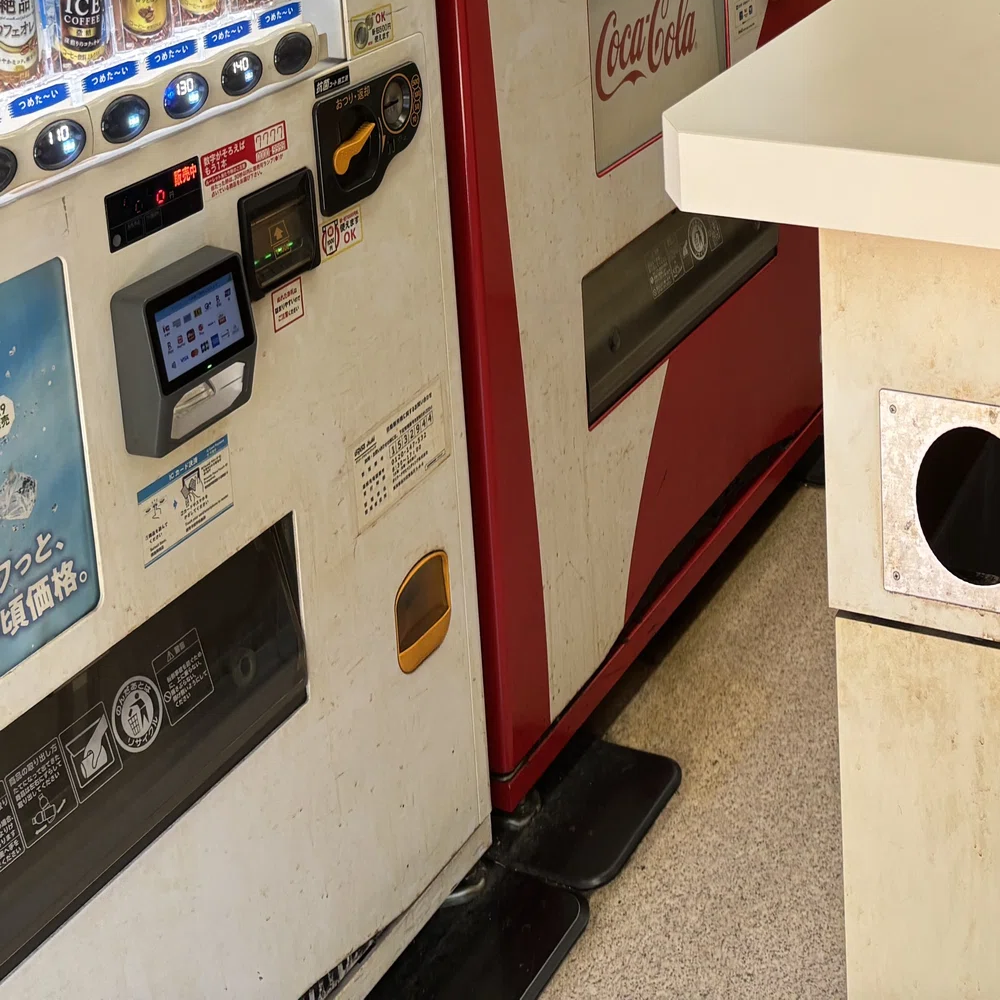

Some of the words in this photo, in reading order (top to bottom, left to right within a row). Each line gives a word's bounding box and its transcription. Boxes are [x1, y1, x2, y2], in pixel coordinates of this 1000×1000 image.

[233, 56, 250, 73] 140
[176, 78, 195, 96] 130
[48, 126, 69, 144] 110
[203, 140, 246, 167] 数字がそろえば
[172, 164, 198, 187] 販売中
[205, 158, 228, 176] もう1本
[343, 227, 357, 244] OK
[115, 682, 152, 717] のんだあとは
[127, 714, 159, 748] リサイクル
